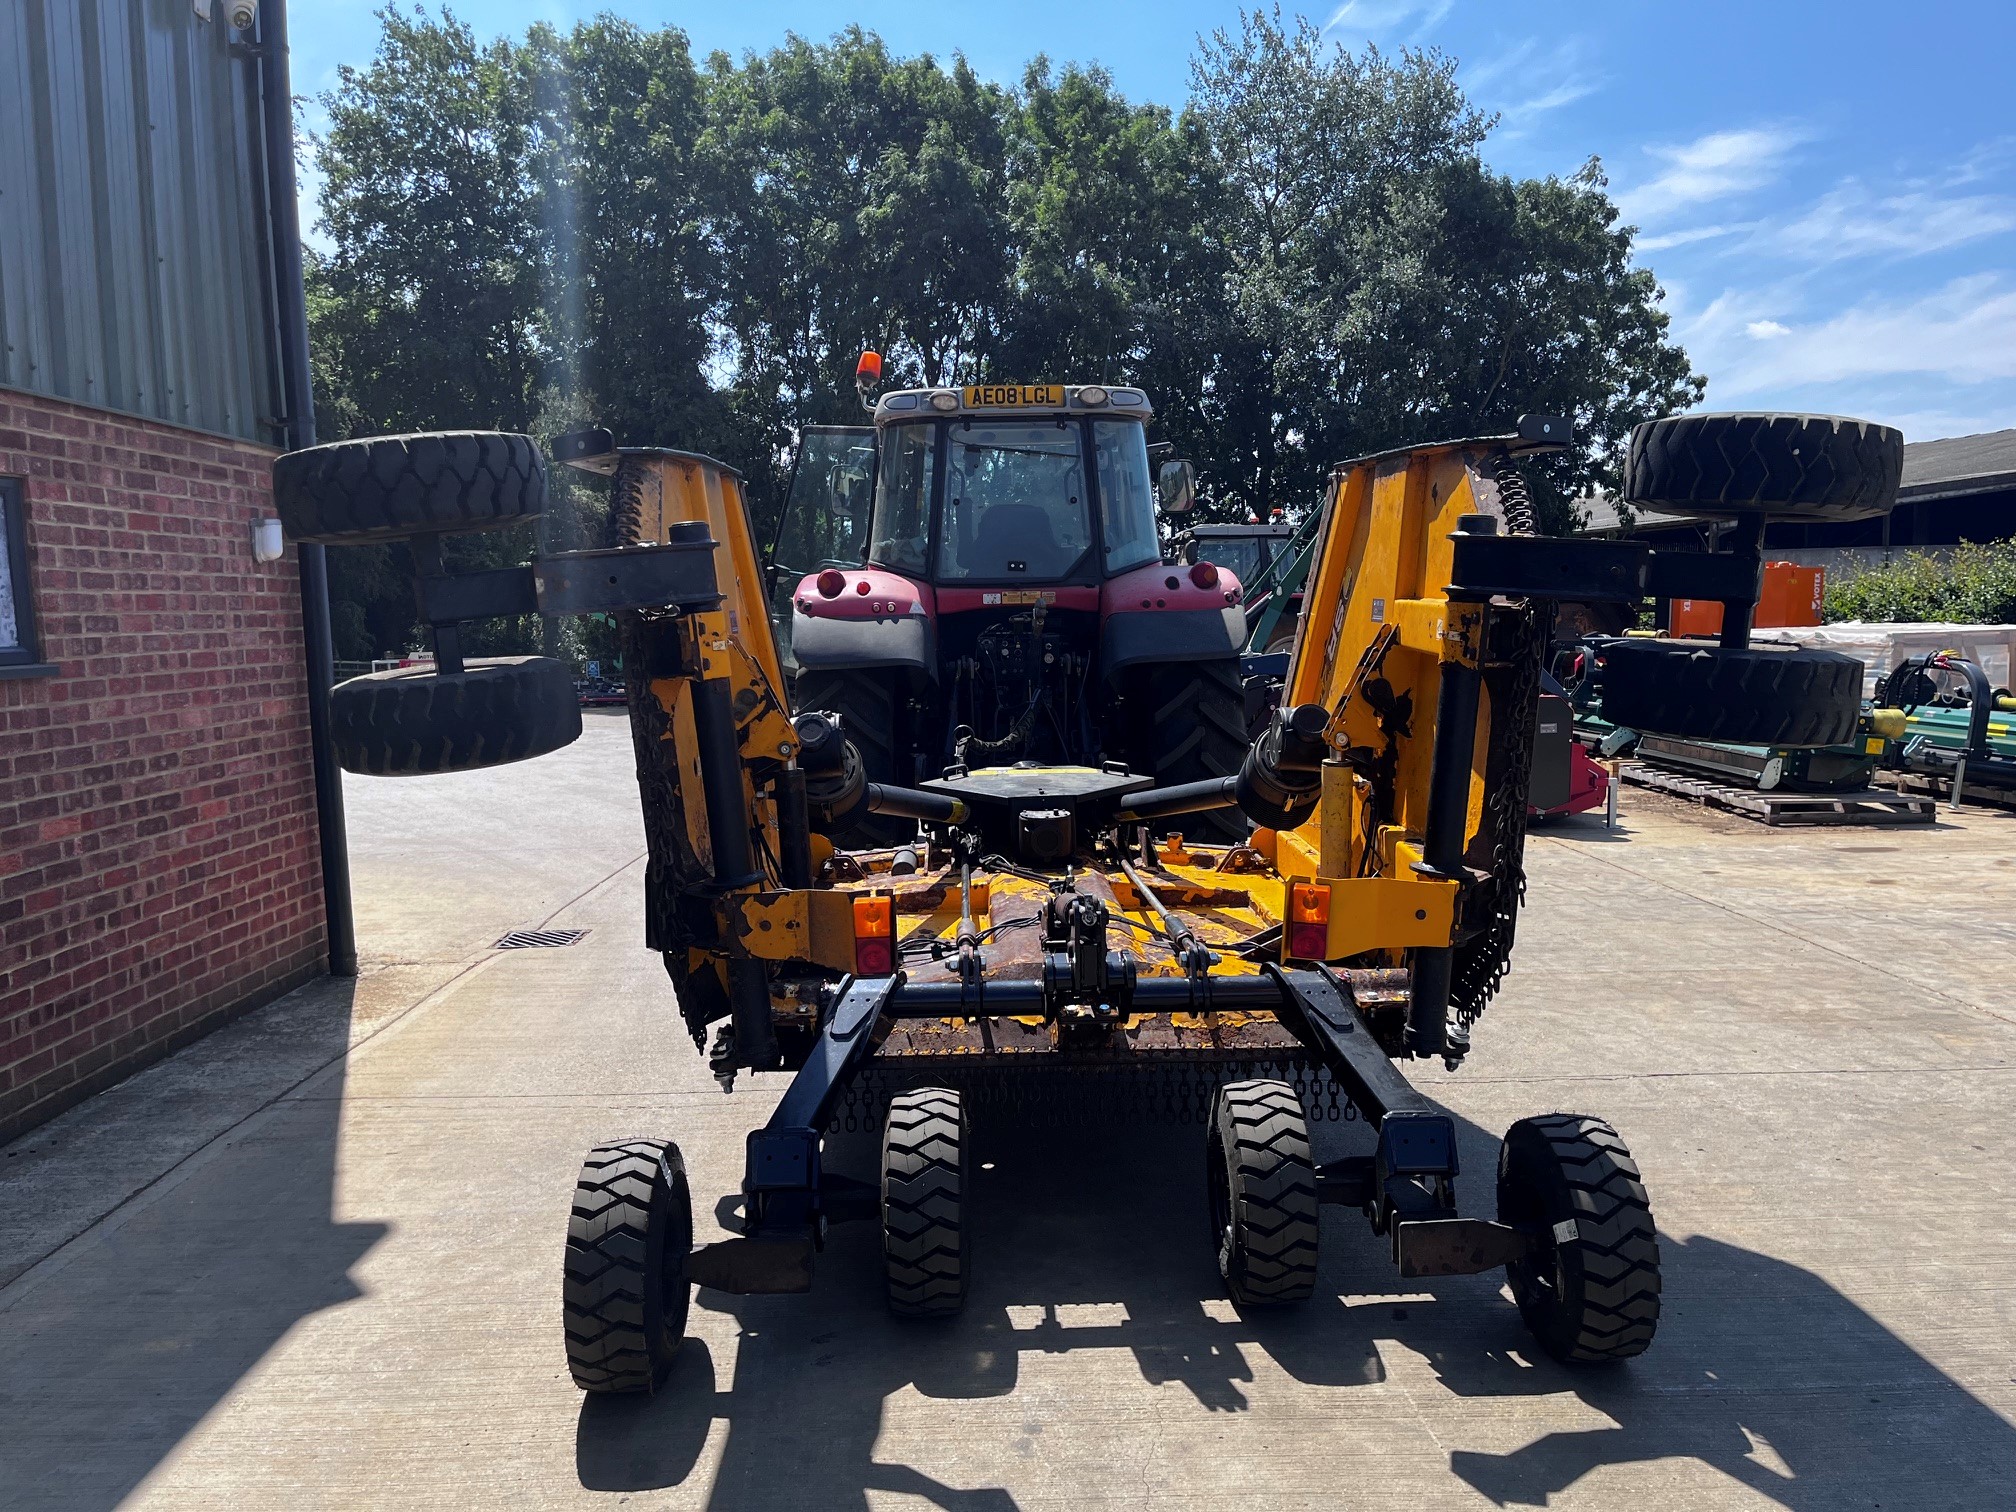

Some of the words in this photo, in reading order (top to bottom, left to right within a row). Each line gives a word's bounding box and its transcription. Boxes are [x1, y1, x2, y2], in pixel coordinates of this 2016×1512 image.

[972, 387, 1017, 404] AE08
[1022, 387, 1056, 404] LGL
[1813, 572, 1821, 599] VOTEX
